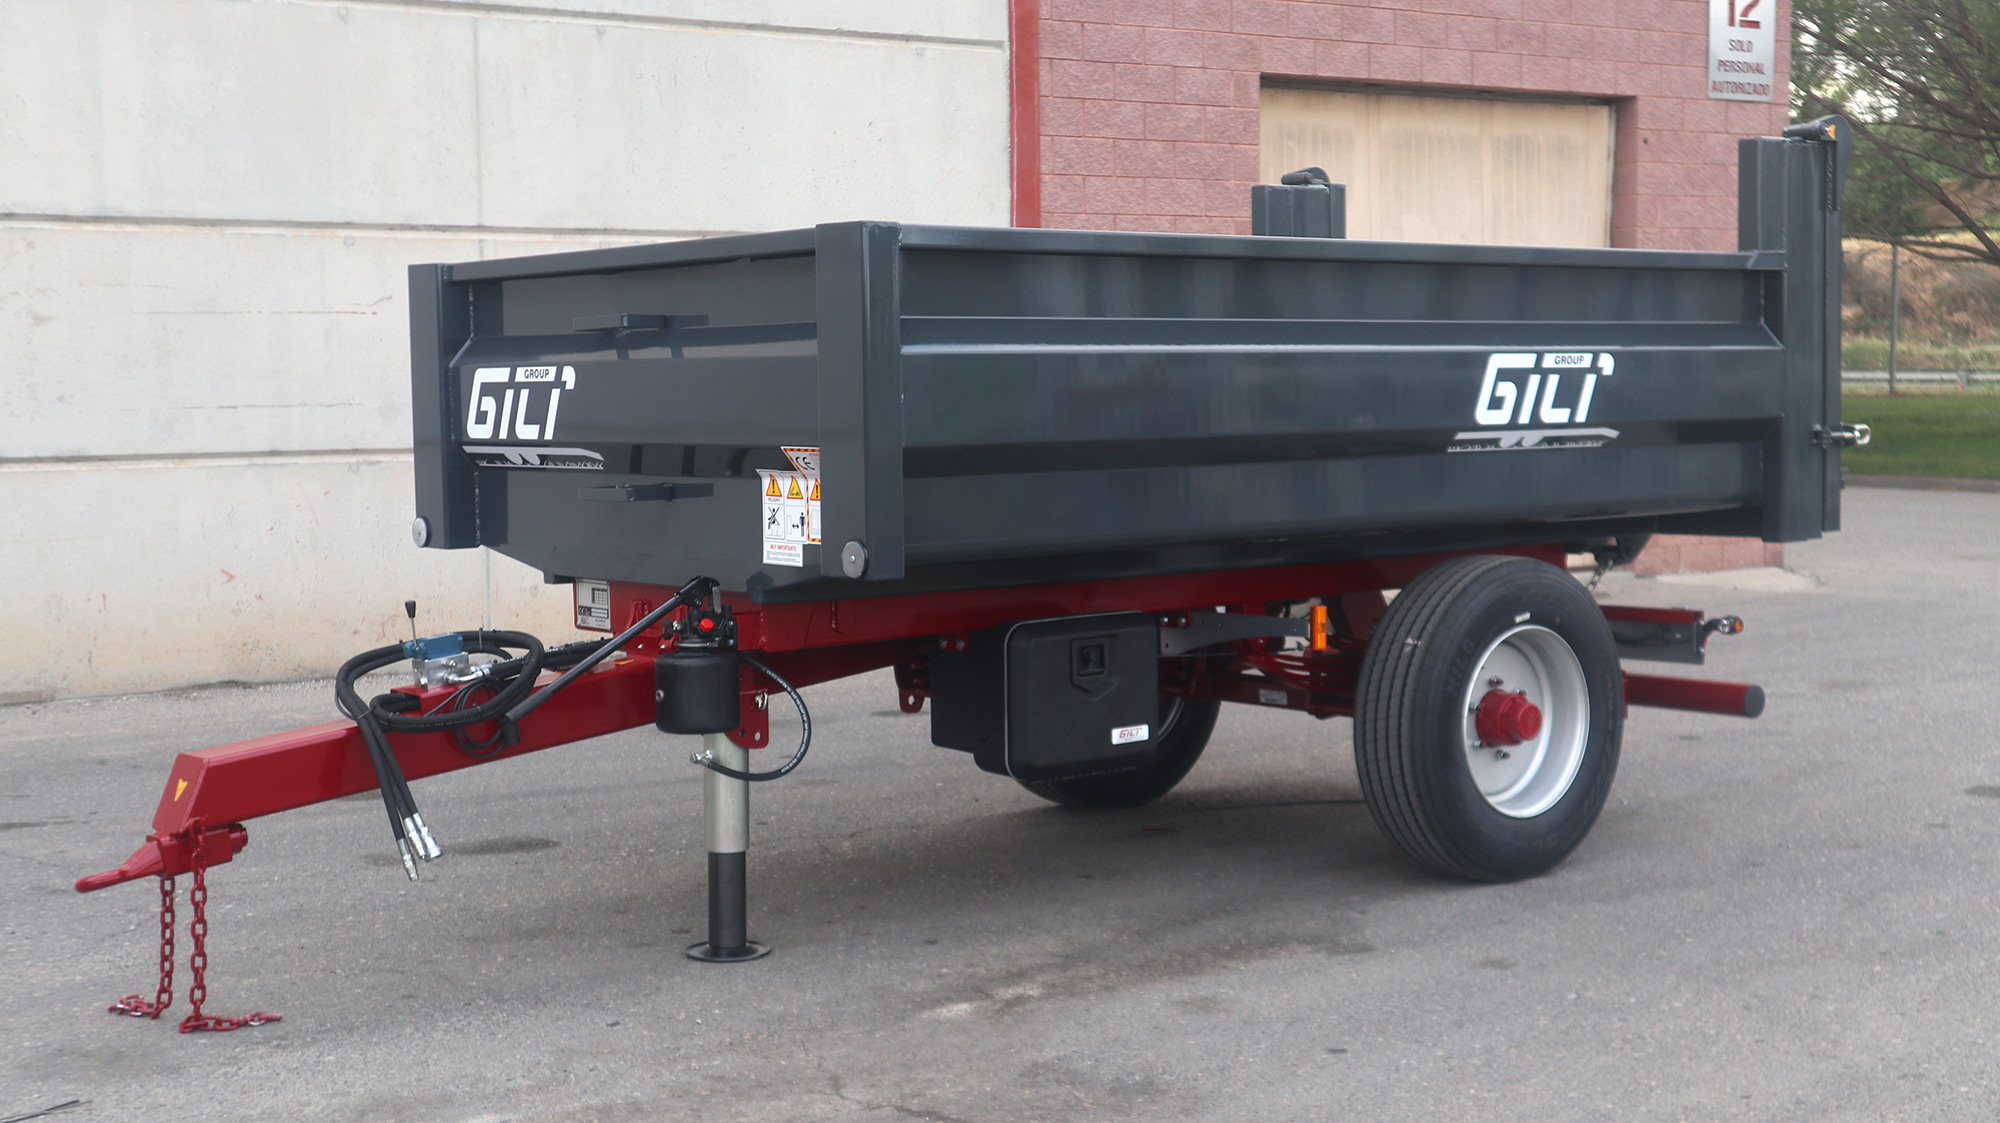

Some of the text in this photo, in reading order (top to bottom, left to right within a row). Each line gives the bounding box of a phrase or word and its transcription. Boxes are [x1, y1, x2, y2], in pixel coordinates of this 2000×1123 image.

[1728, 0, 1760, 29] 12
[1728, 39, 1753, 53] SOLO
[1717, 59, 1766, 75] PERSONAL
[1711, 80, 1771, 96] AUTORIZADO
[1554, 355, 1585, 365] GROUP
[524, 368, 550, 379] GROUP
